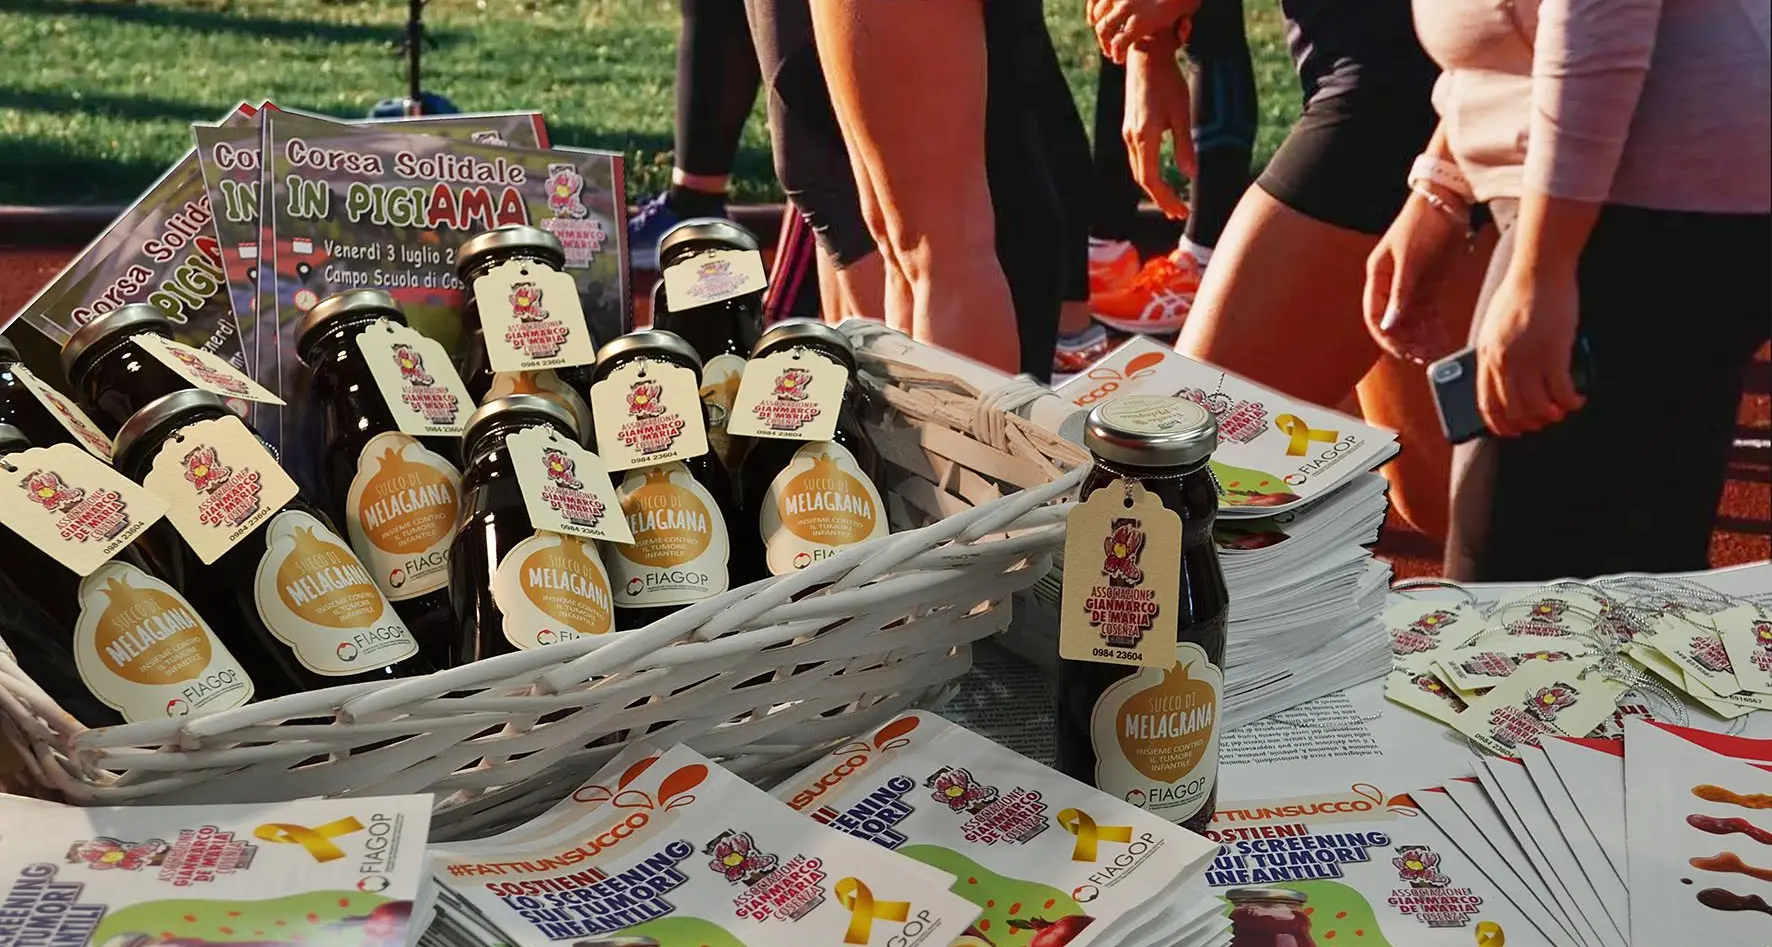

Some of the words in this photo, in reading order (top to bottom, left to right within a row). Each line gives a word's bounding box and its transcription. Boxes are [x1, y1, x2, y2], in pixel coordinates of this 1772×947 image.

[285, 138, 384, 175] Corsa
[395, 151, 527, 185] Solidale
[285, 175, 330, 218] IN
[346, 182, 529, 230] PIGIAMA
[324, 240, 382, 261] Venerdì
[387, 244, 396, 261] 3
[402, 244, 440, 266] luglio
[324, 267, 368, 287] Campo
[373, 270, 419, 287] Scuola
[424, 272, 438, 288] di
[505, 327, 568, 341] GIANMARCO
[513, 338, 525, 347] DE
[530, 334, 565, 345] MARIA
[754, 406, 818, 415] GIANMARCO
[777, 412, 812, 421] MARIA
[1219, 403, 1260, 432] MARCO
[1227, 410, 1263, 436] MARIA
[617, 420, 683, 439] GIANMARCO
[625, 434, 640, 445] DE
[643, 428, 677, 442] MARIA
[631, 456, 651, 465] 0984
[653, 451, 678, 461] 23604
[1299, 435, 1356, 475] FIAGOP
[375, 477, 403, 496] SUCCO
[803, 478, 832, 491] SUCCO
[835, 479, 848, 492] DI
[199, 472, 259, 525] GIANMARCO
[210, 511, 224, 527] DE
[225, 484, 261, 514] MARIA
[363, 484, 452, 531] MELAGRANA
[542, 492, 603, 510] GIANMARCO
[551, 500, 562, 510] DE
[566, 503, 600, 515] MARIA
[785, 491, 871, 520] MELAGRANA
[60, 491, 117, 540] GIANMARCO
[74, 524, 89, 541] DE
[89, 501, 122, 529] MARIA
[229, 524, 248, 542] 0984
[249, 506, 271, 525] 23604
[103, 538, 122, 555] 0984
[123, 520, 145, 540] 23604
[549, 555, 576, 572] SUCCO
[286, 565, 370, 606] MELAGRANA
[529, 567, 609, 612] MELAGRANA
[645, 570, 709, 587] FIAGOP
[1086, 598, 1157, 614] GIANMARCO
[1091, 586, 1150, 600] ASSOCIAZIONE
[1092, 610, 1106, 623] DE
[1111, 611, 1149, 626] MARIA
[1101, 622, 1140, 637] COSENZA
[105, 607, 195, 667] MELAGRANA
[354, 625, 405, 650] FIAGOP
[1093, 648, 1114, 658] 0984
[1116, 650, 1143, 661] 23604
[182, 669, 237, 702] FIAGOP
[1150, 695, 1182, 713] SUCCO
[1185, 691, 1196, 707] DI
[1125, 702, 1212, 740] MELAGRANA
[1492, 716, 1505, 726] DE
[1506, 722, 1538, 744] MARIA
[1136, 744, 1171, 755] INSIEME
[1173, 739, 1203, 753] CONTRO
[1474, 733, 1492, 747] 0984
[1151, 759, 1190, 771] INFANTILE
[1159, 752, 1193, 763] TUMORE
[1149, 777, 1206, 802] FIAGOP
[960, 786, 1024, 833] ASSOCIAZIONE
[964, 792, 1038, 843] GIANMARCO
[1212, 800, 1373, 824] TTIUNSUCCO
[982, 830, 1000, 845] DE
[1000, 804, 1040, 834] MARIA
[1001, 815, 1045, 844] COSENZA
[1204, 823, 1306, 844] OSTIENI
[200, 831, 232, 866] MARIA
[359, 813, 393, 874] FIAGOP
[447, 812, 649, 877] #FATTIUNSUCCO
[1235, 831, 1388, 854] SCREENING
[173, 825, 214, 887] GIANMARCO
[1089, 832, 1155, 886] FIAGOP
[1254, 847, 1367, 868] TUMORI
[194, 867, 212, 883] DE
[485, 867, 608, 897] SOSTIENI
[503, 892, 544, 911] LO
[547, 840, 693, 907] SCREENING
[732, 854, 804, 908] ASSOCIAZIONE
[1204, 863, 1341, 886] INFANTILI
[519, 904, 570, 925] SUI
[573, 868, 688, 919] TUMORI
[735, 857, 820, 919] GIANMARCO
[752, 905, 772, 922] DE
[774, 871, 823, 908] MARIA
[1388, 895, 1481, 906] GIANMARCO
[1392, 887, 1469, 897] ASSOCIAZIONE
[774, 885, 822, 920] COSENZA
[1400, 904, 1412, 914] DE
[1420, 904, 1476, 913] MARIA
[537, 898, 675, 941] INFANTILI
[886, 909, 931, 947] GOP
